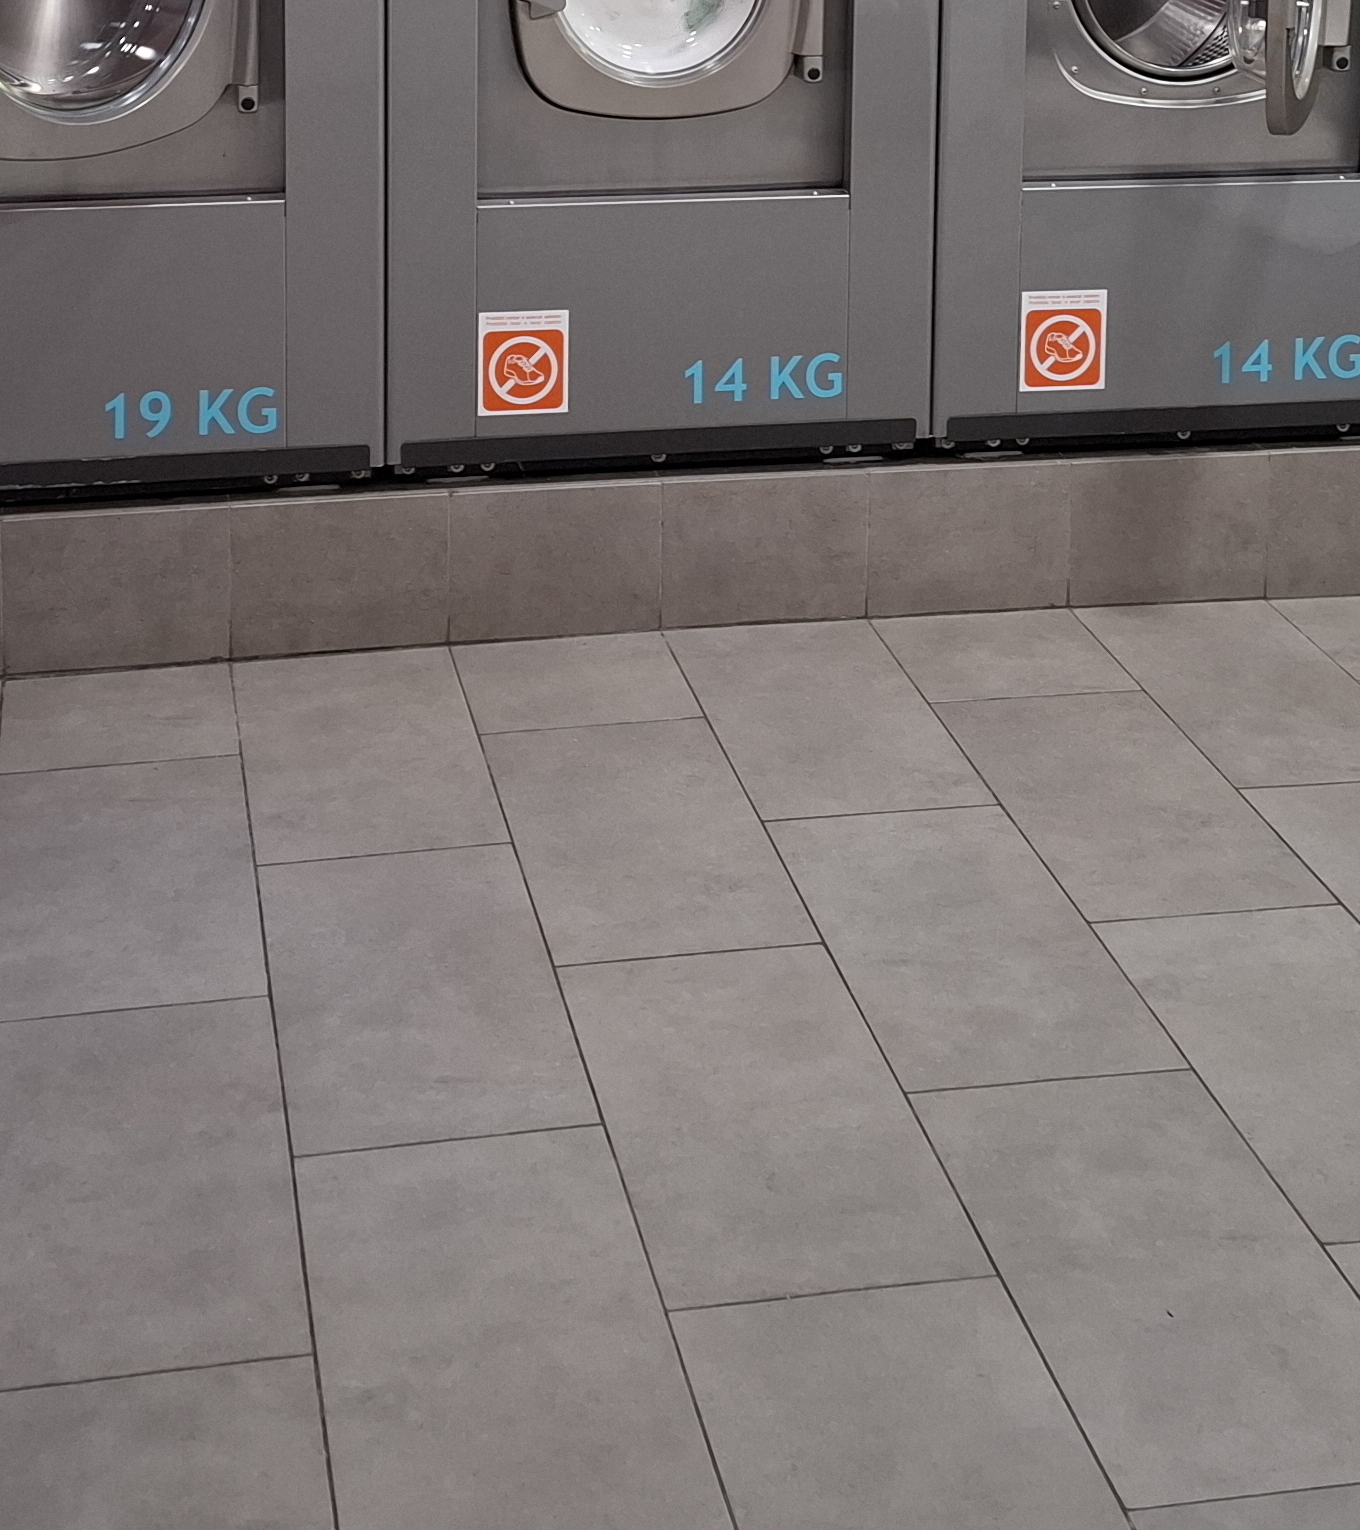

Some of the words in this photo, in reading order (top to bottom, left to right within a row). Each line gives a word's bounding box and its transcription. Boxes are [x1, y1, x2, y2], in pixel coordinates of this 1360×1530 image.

[684, 357, 747, 403] 14
[770, 352, 842, 399] KG
[1214, 338, 1272, 383] 14
[105, 390, 171, 438] 19
[198, 386, 277, 435] KG
